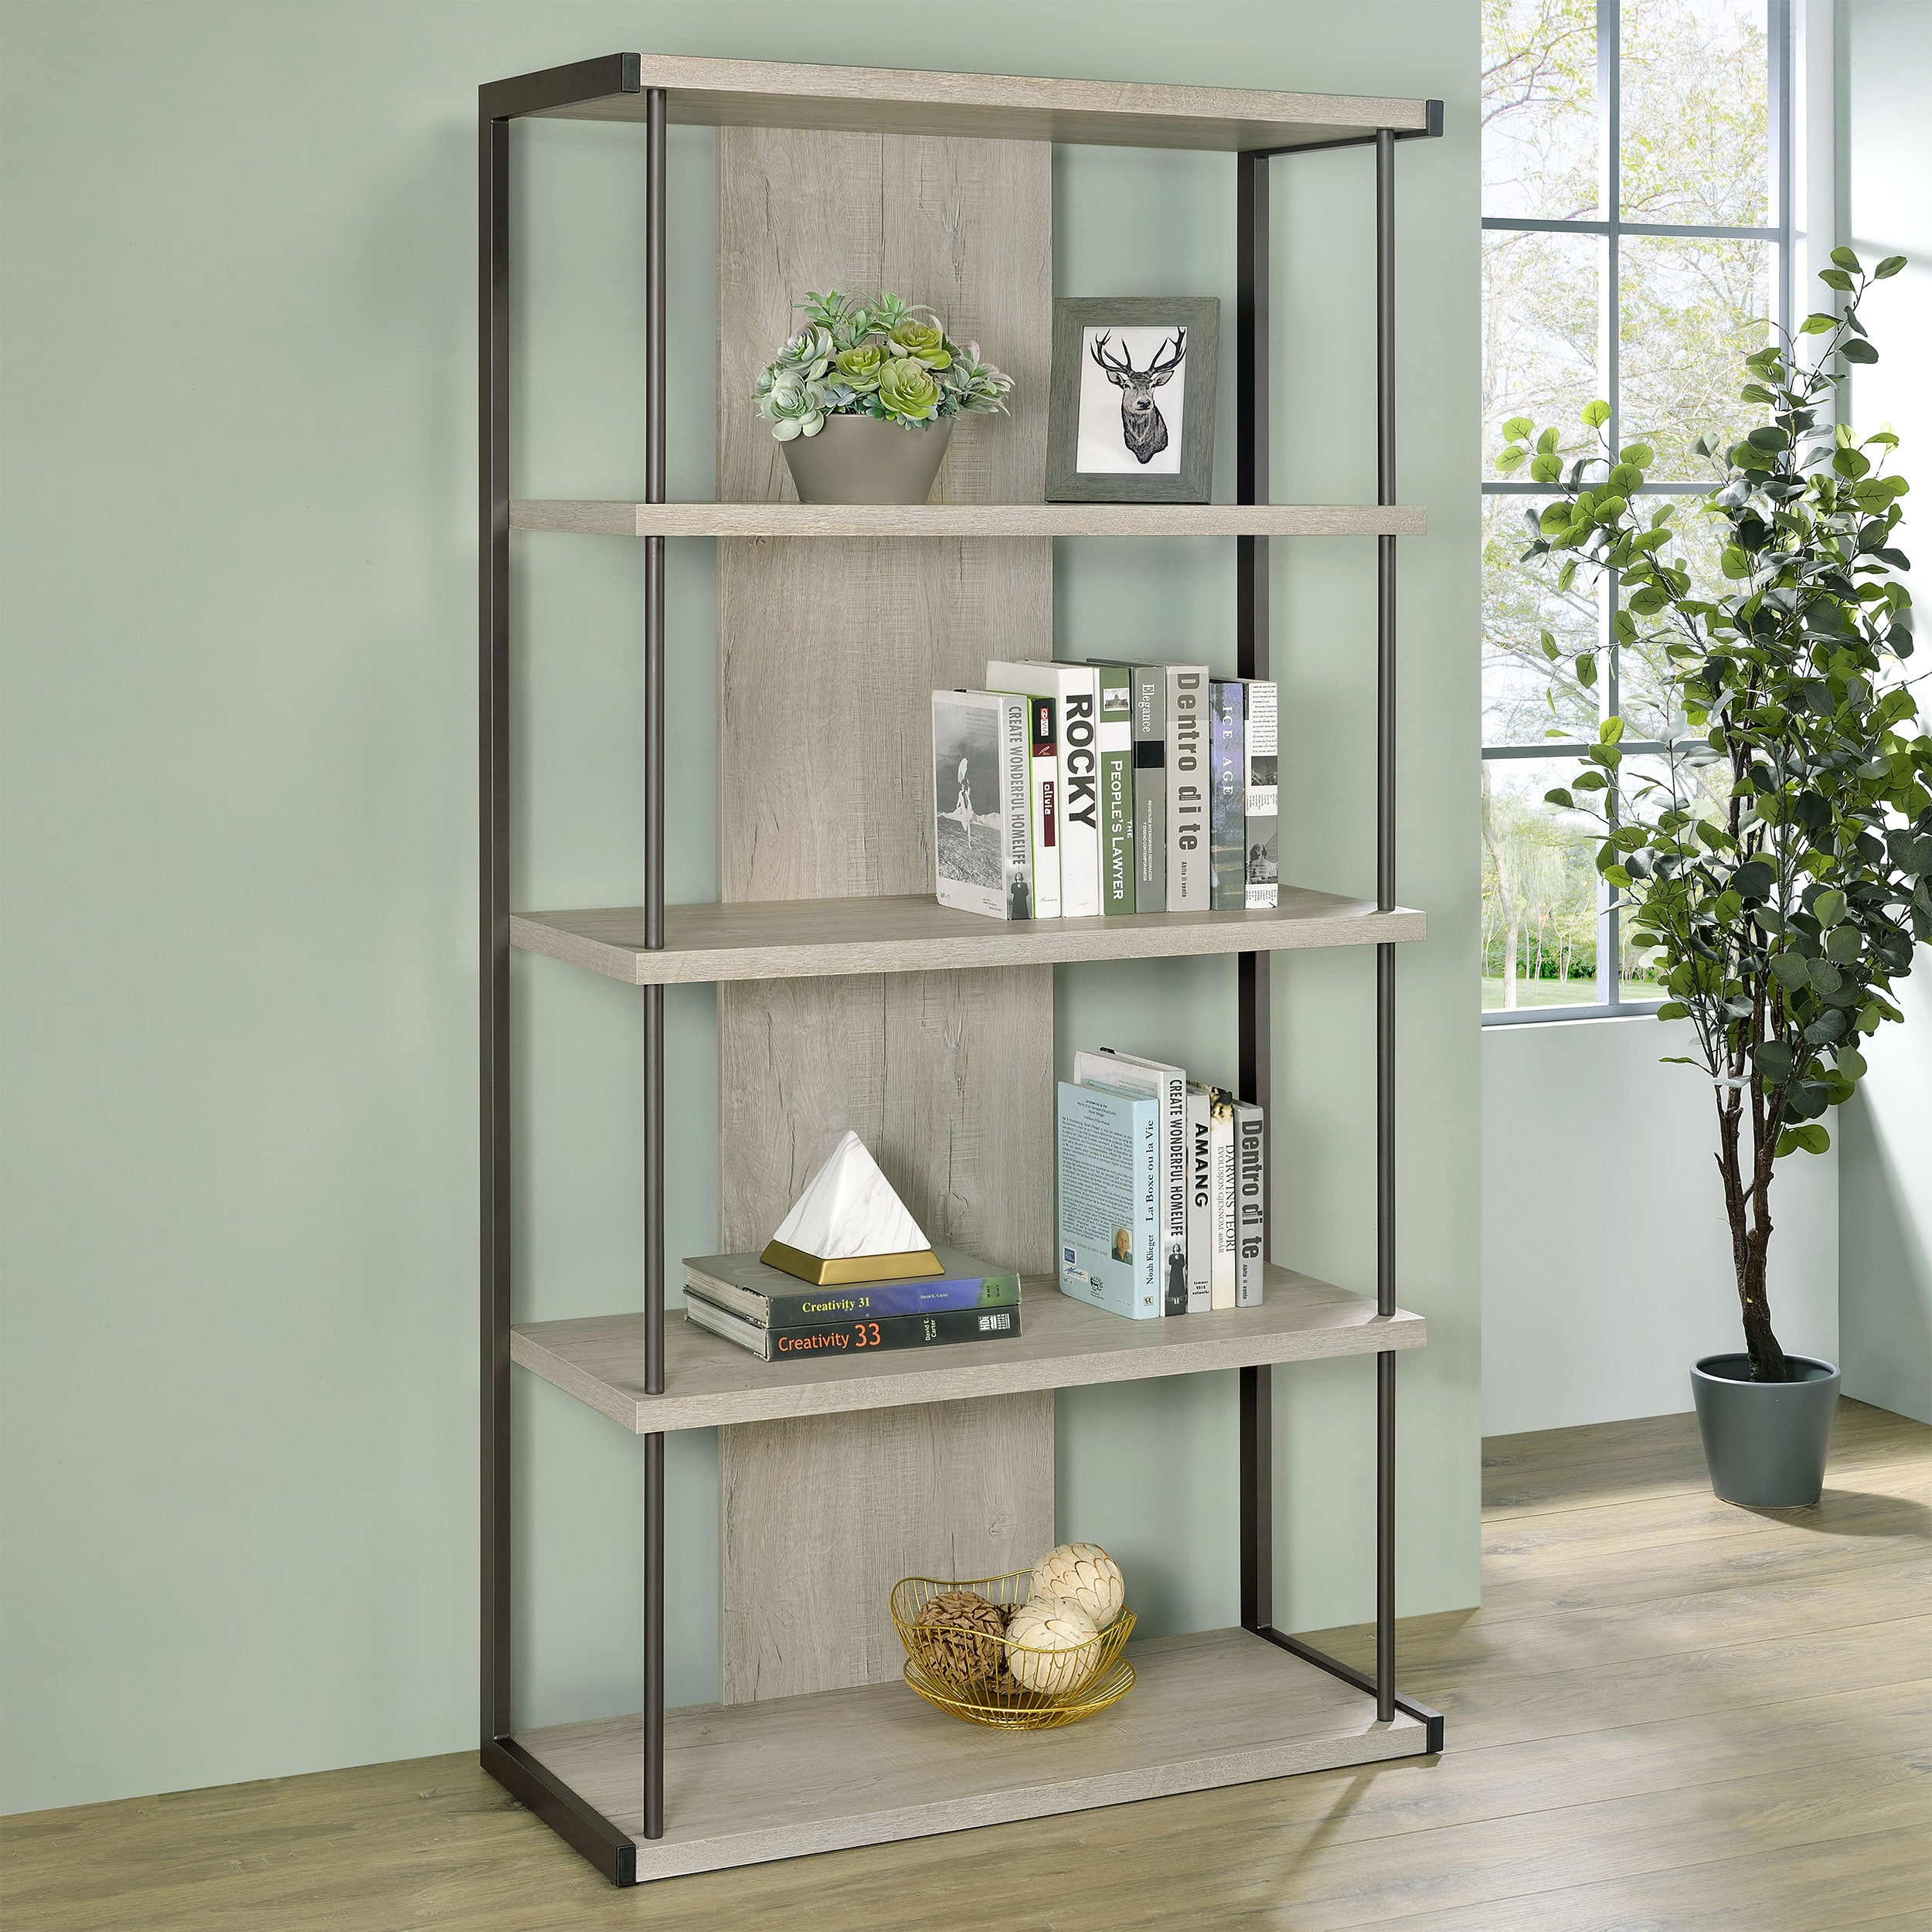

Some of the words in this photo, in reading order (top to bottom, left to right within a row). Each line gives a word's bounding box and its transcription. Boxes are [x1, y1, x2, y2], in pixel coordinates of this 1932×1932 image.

[1009, 706, 1022, 743] CREATE
[1138, 683, 1155, 733] Elegance
[1178, 673, 1199, 770] Dentro
[1223, 706, 1233, 739] ICE
[1009, 746, 1025, 811] WONDERFUL
[1066, 694, 1096, 829] ROCKY
[1223, 757, 1233, 795] AGE
[1043, 784, 1053, 815] olivia
[1111, 760, 1124, 832] PEOPLE'S
[1179, 786, 1201, 814] di
[1012, 814, 1026, 865] HOMELIFE
[1179, 823, 1200, 850] te
[1112, 836, 1124, 900] LAWYER
[1169, 1079, 1182, 1115] CREATE
[1145, 1120, 1154, 1139] Vie
[1146, 1143, 1154, 1152] la
[1148, 1156, 1154, 1171] ou
[1170, 1118, 1183, 1182] WONDERFUL
[1195, 1123, 1209, 1208] AMANG
[1242, 1120, 1263, 1196] Dentro
[1226, 1145, 1235, 1207] DARWINS
[1145, 1206, 1154, 1222] La
[1170, 1185, 1183, 1236] HOMELIFE
[1242, 1203, 1263, 1225] di
[1146, 1235, 1155, 1261] Klieger
[1226, 1213, 1235, 1252] TEORI
[1242, 1236, 1262, 1259] te
[802, 1299, 855, 1313] Creativity
[858, 1297, 870, 1308] 31
[778, 1332, 849, 1352] Creativity
[855, 1322, 881, 1347] 33
